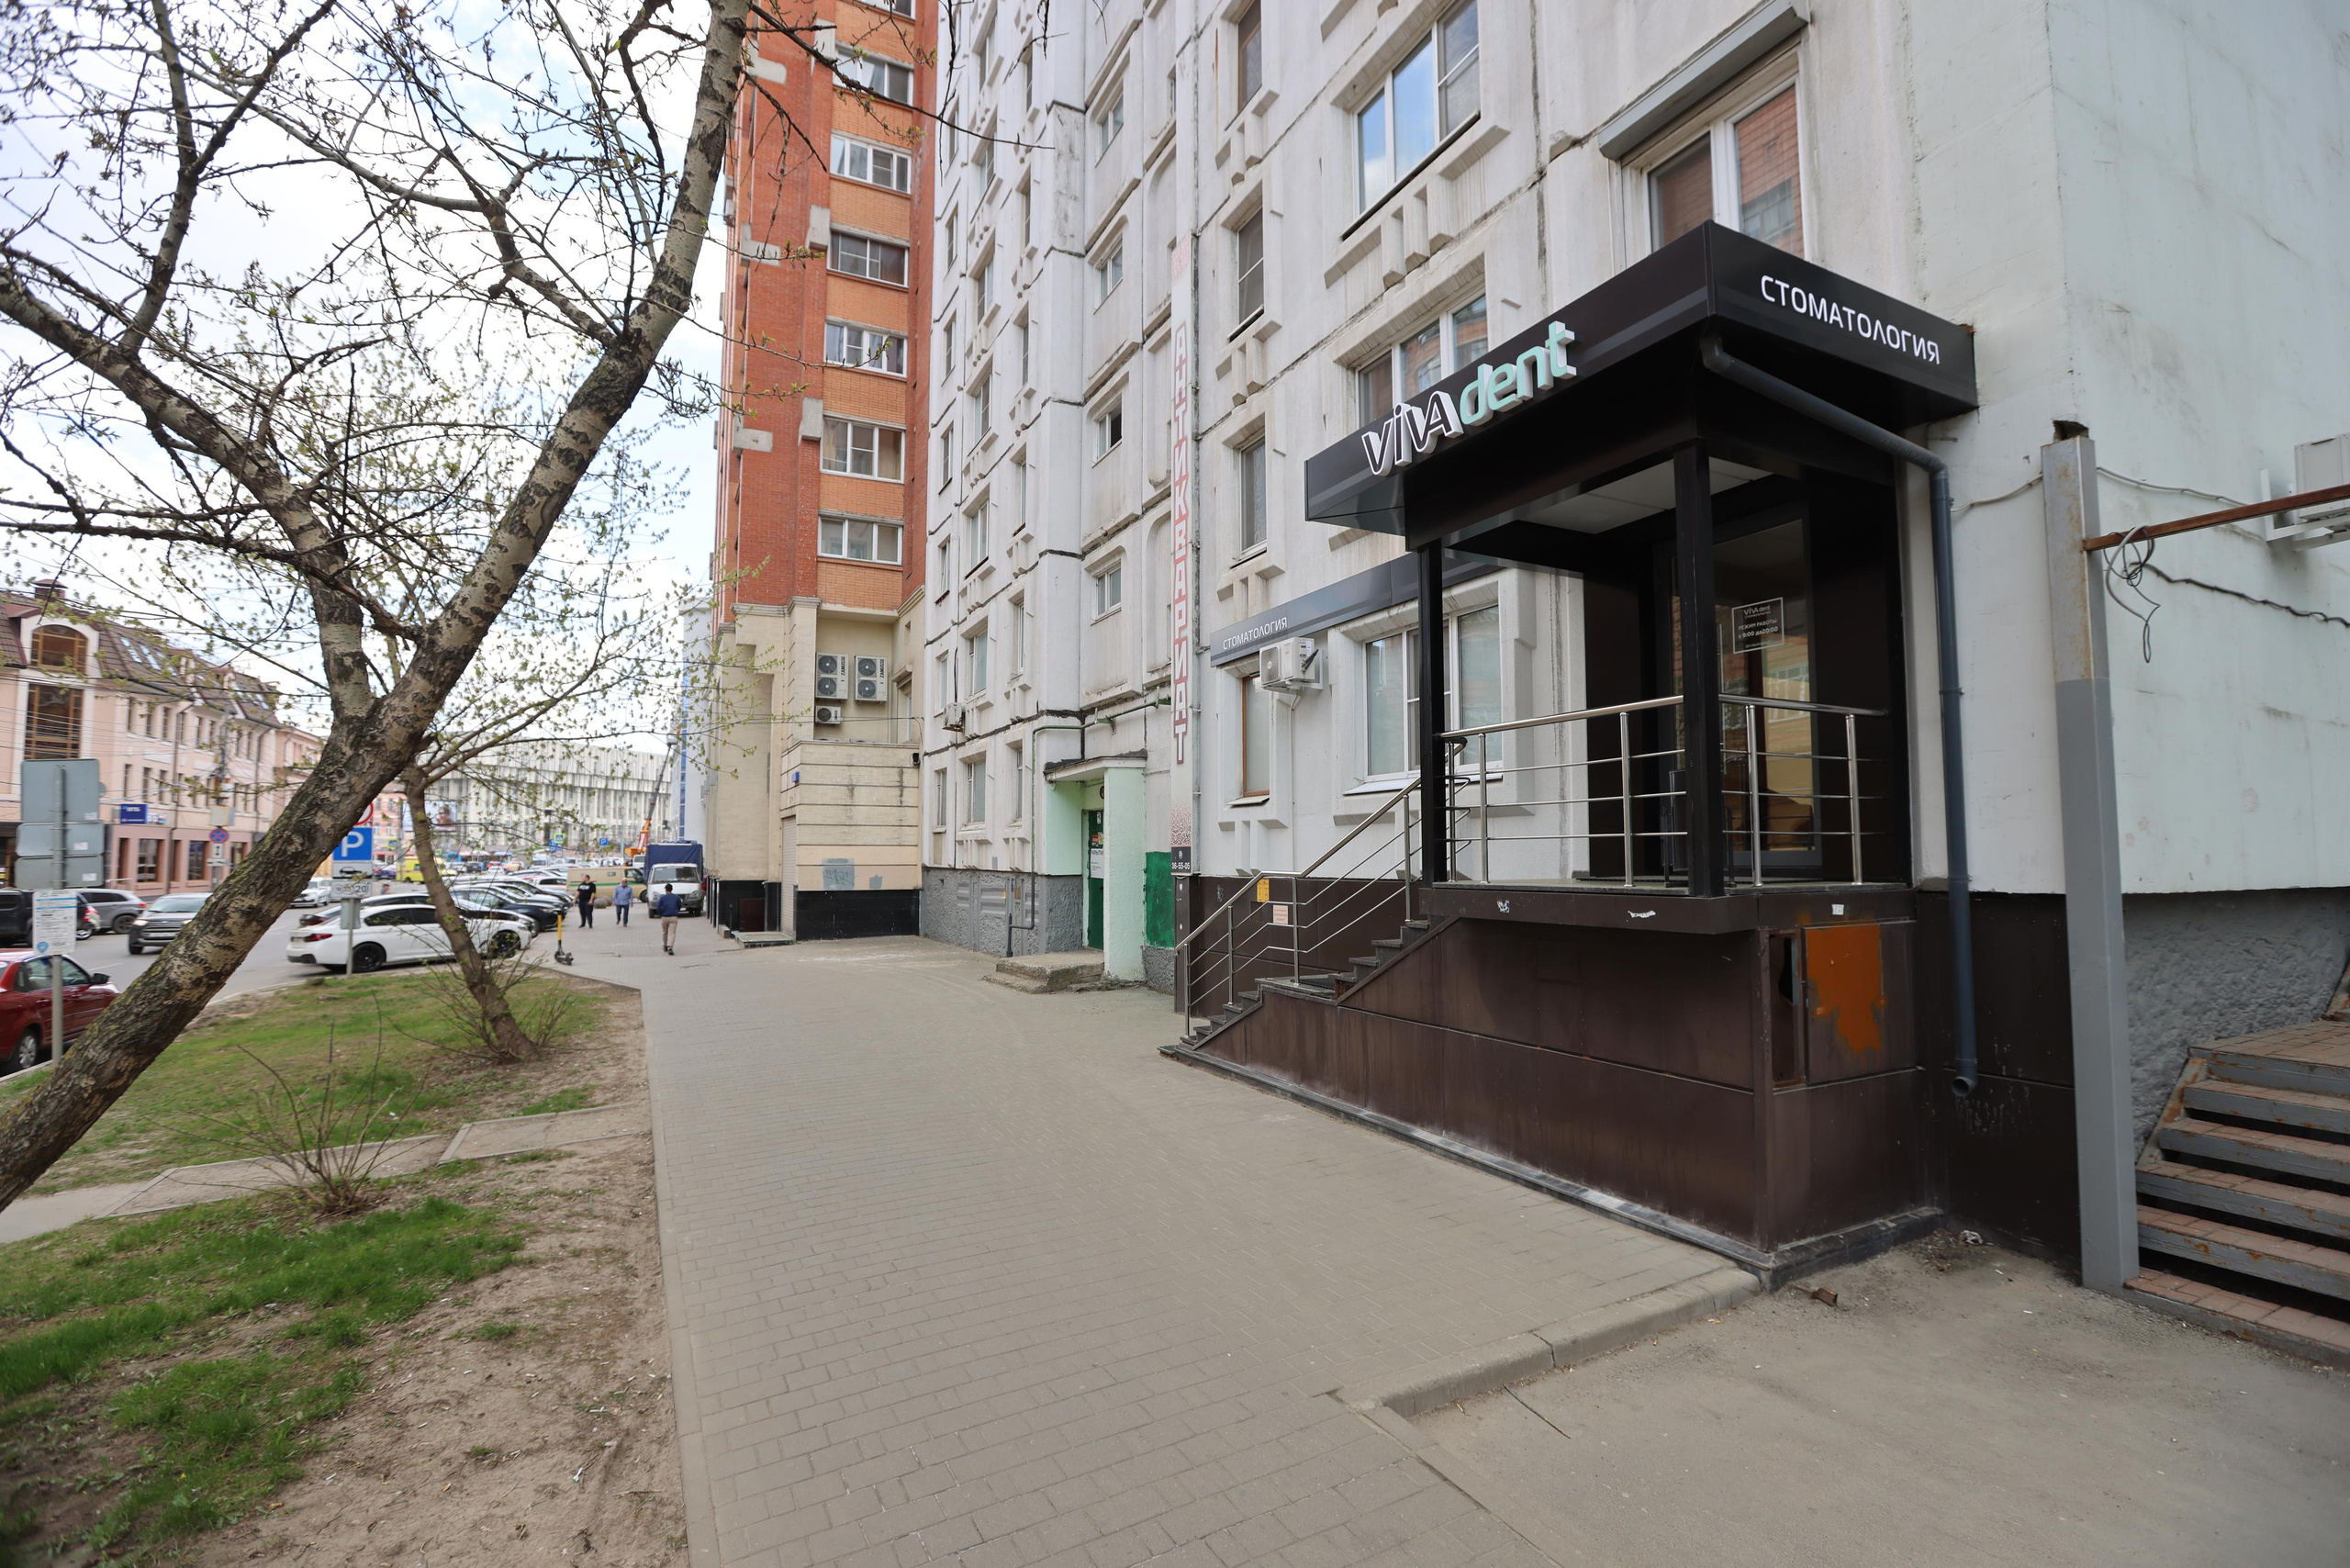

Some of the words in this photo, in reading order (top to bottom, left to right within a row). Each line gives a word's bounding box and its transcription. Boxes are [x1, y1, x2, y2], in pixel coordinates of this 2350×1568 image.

[1761, 274, 1941, 365] СТОМАТОЛОГИЯ
[1174, 321, 1188, 765] АНТИКВАРИАТ
[1223, 617, 1288, 650] СТОМАТОЛОГИЯ
